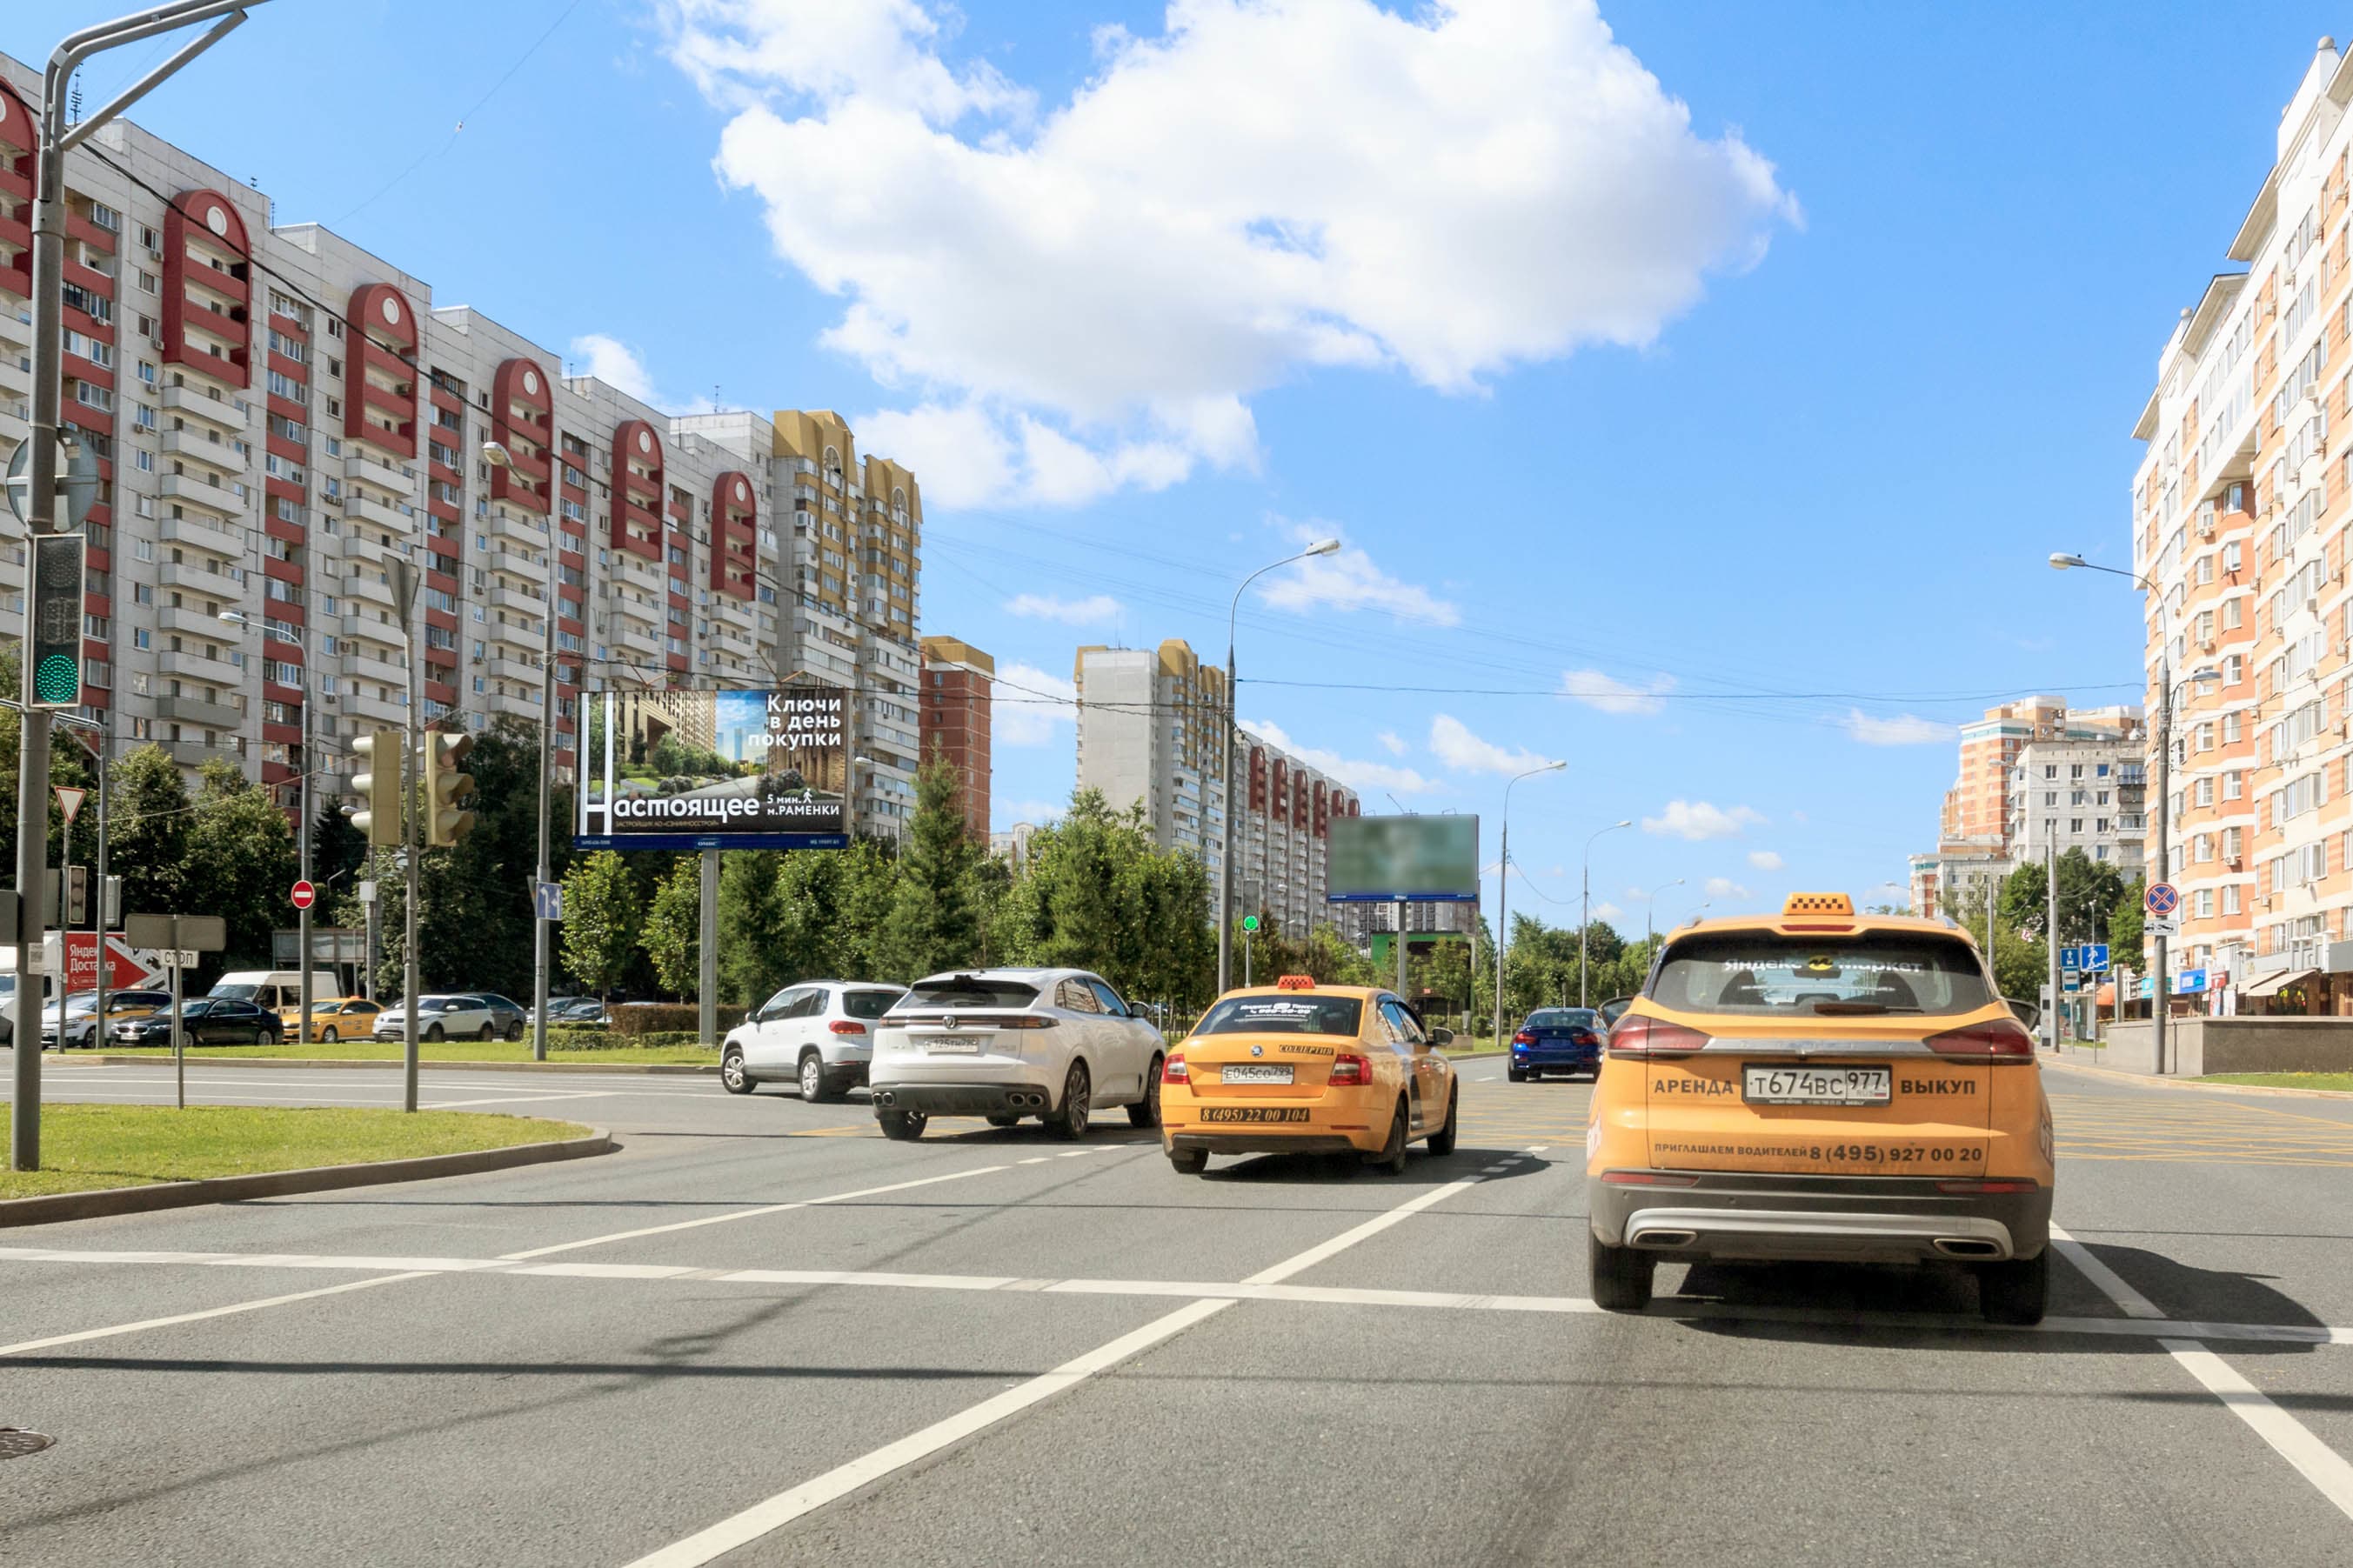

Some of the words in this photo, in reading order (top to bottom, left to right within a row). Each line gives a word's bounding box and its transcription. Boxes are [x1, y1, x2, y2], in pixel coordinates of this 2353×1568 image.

[767, 694, 841, 712] Ключи
[770, 716, 781, 729] в
[788, 715, 841, 731] день
[748, 733, 841, 751] покупки
[579, 691, 759, 835] Настоящее
[766, 793, 773, 804] 5
[777, 796, 802, 804] мин.
[766, 804, 839, 816] м.РАМЕНКИ
[70, 957, 117, 974] Достака
[1654, 1079, 1734, 1097] АРЕНДА
[1848, 1071, 1883, 1090] 977
[1901, 1080, 1975, 1095] ВЫКУП
[1202, 1109, 1210, 1121] 8
[1213, 1109, 1244, 1121] (495)
[1246, 1109, 1261, 1121] 22
[1265, 1109, 1280, 1121] 00
[1285, 1109, 1307, 1121] 104
[1654, 1144, 1735, 1155] ПРИГЛАШАЕМ
[1737, 1145, 1808, 1157] ВОДИТЕЛЕЙ
[1809, 1147, 1822, 1160] 8
[1827, 1144, 1885, 1164] (495)
[1889, 1148, 1926, 1161] 927
[1930, 1148, 1955, 1162] 00
[1959, 1148, 1982, 1162] 20
